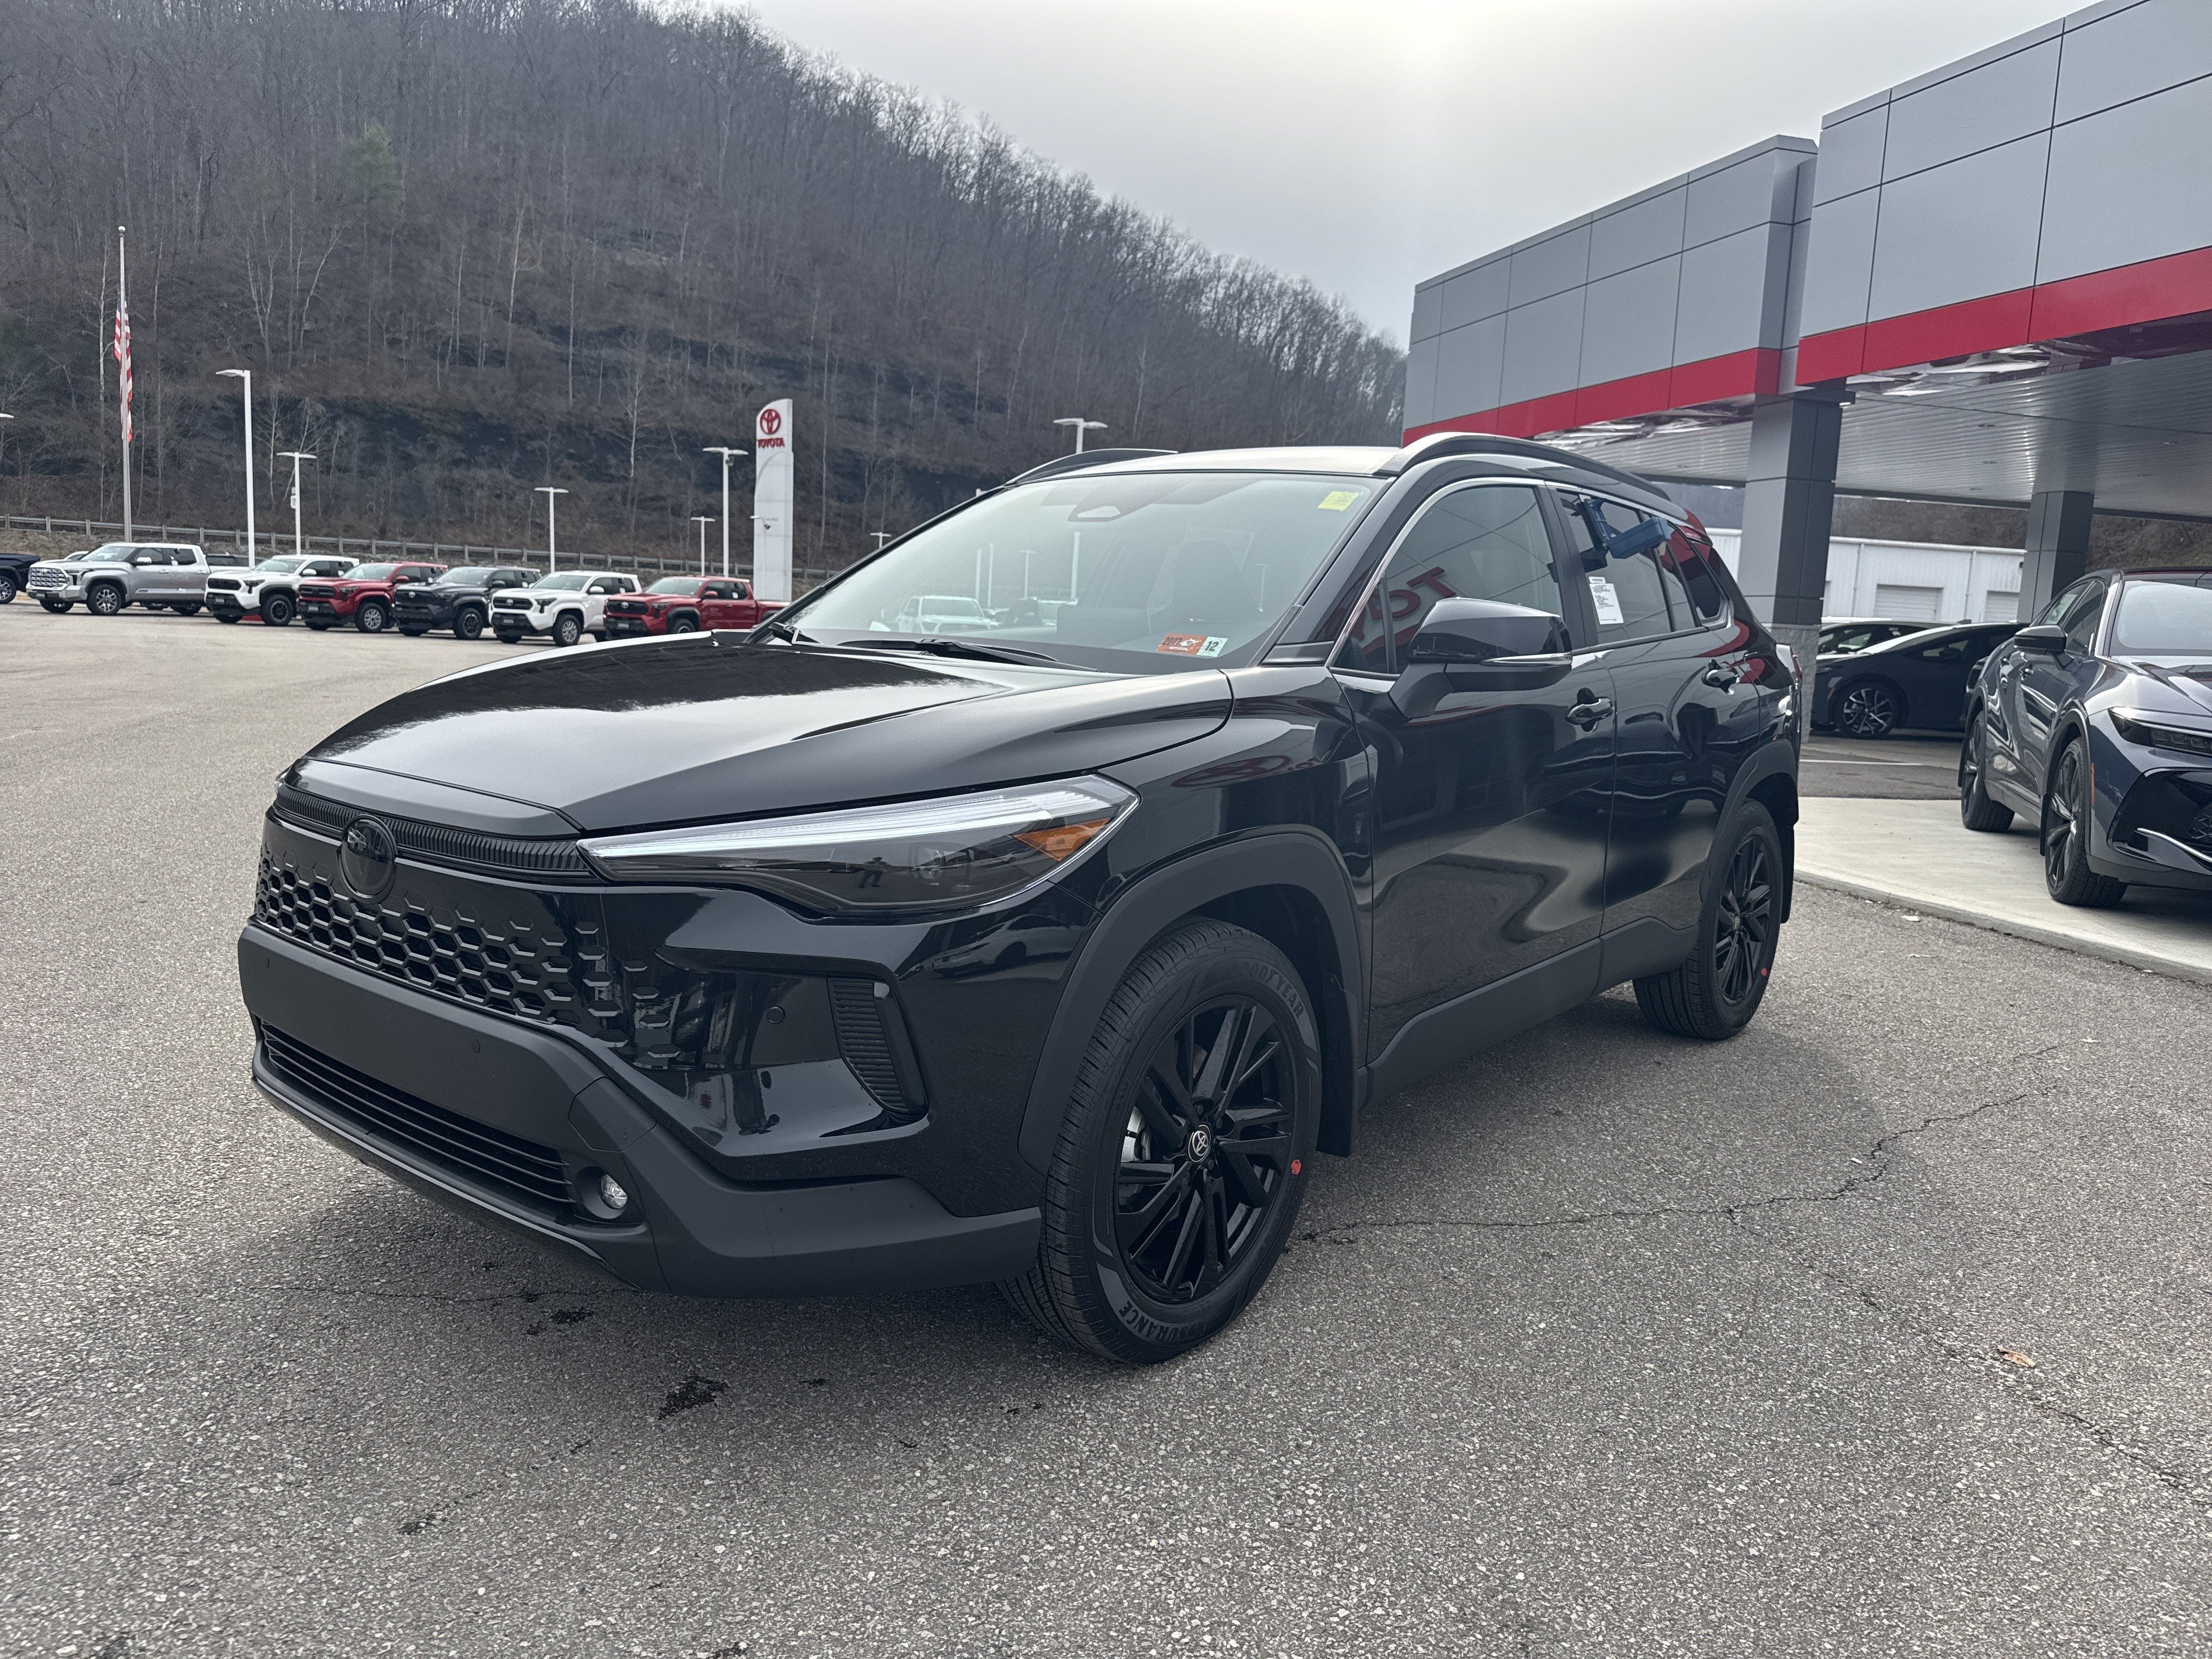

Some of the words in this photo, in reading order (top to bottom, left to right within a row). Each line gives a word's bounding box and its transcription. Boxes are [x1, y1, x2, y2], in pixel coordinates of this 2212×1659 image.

[758, 438, 785, 448] TOYOTA
[1205, 641, 1218, 652] 12
[1229, 961, 1304, 1019] GOODYEAR
